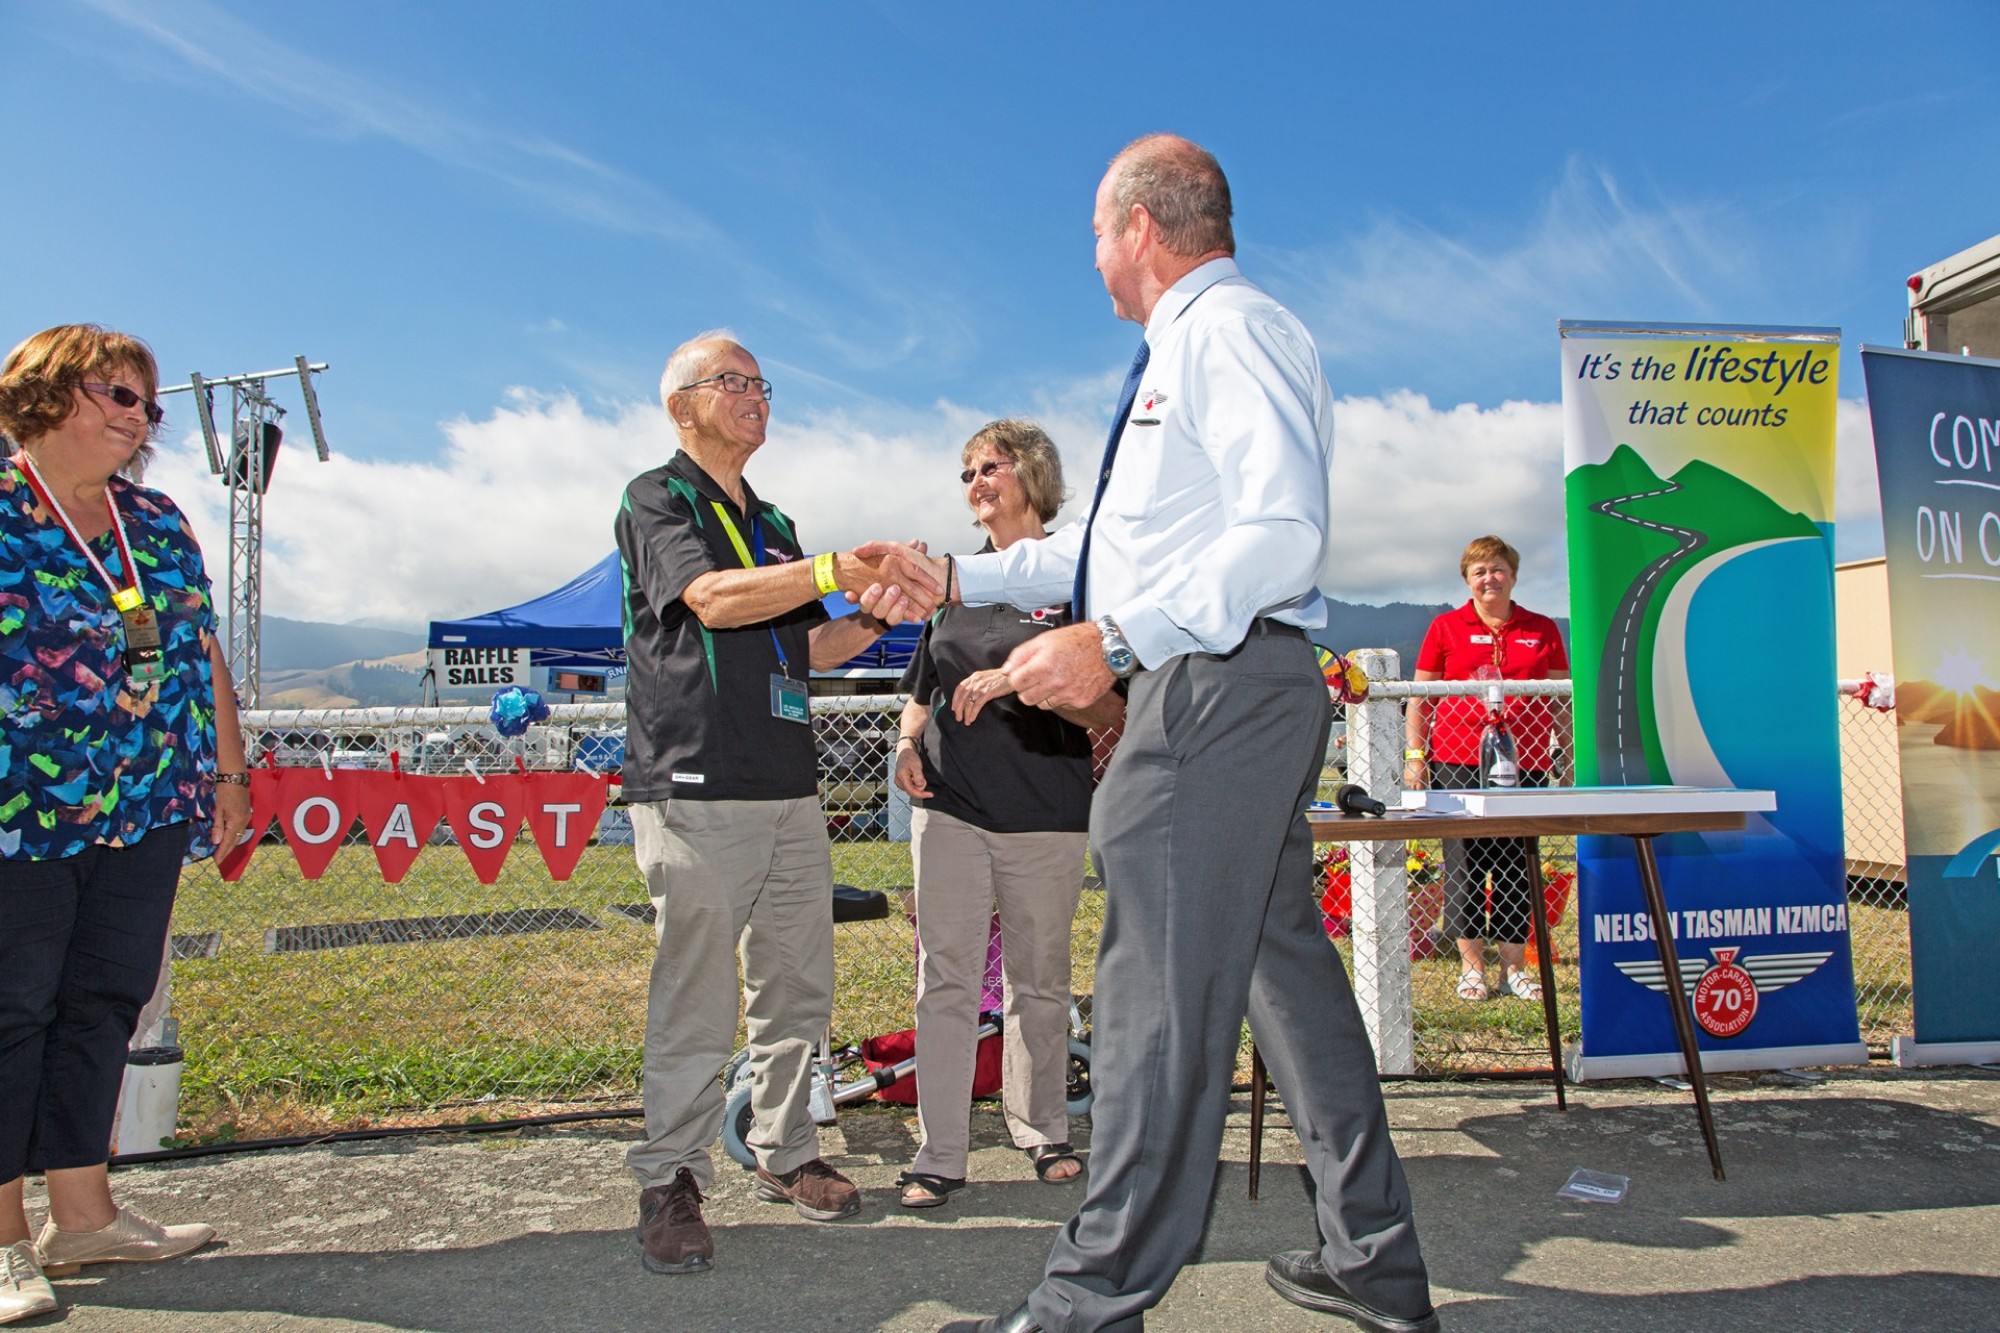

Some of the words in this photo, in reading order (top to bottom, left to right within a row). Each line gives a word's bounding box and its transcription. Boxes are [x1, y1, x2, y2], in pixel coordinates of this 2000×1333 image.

[1577, 353, 1622, 380] It's
[1630, 356, 1676, 381] the
[1684, 344, 1829, 396] lifestyle
[1628, 400, 1688, 425] that
[1697, 403, 1788, 427] counts
[1916, 506, 1963, 564] ON
[444, 647, 519, 666] RAFFLE
[448, 666, 514, 685] SALES
[236, 796, 581, 849] OAST
[1683, 907, 1771, 939] TASMAN
[1776, 904, 1847, 934] NZMCA
[1720, 952, 1730, 962] NZ
[1710, 988, 1741, 1012] 70
[1700, 1008, 1750, 1032] ASSOCIATION
